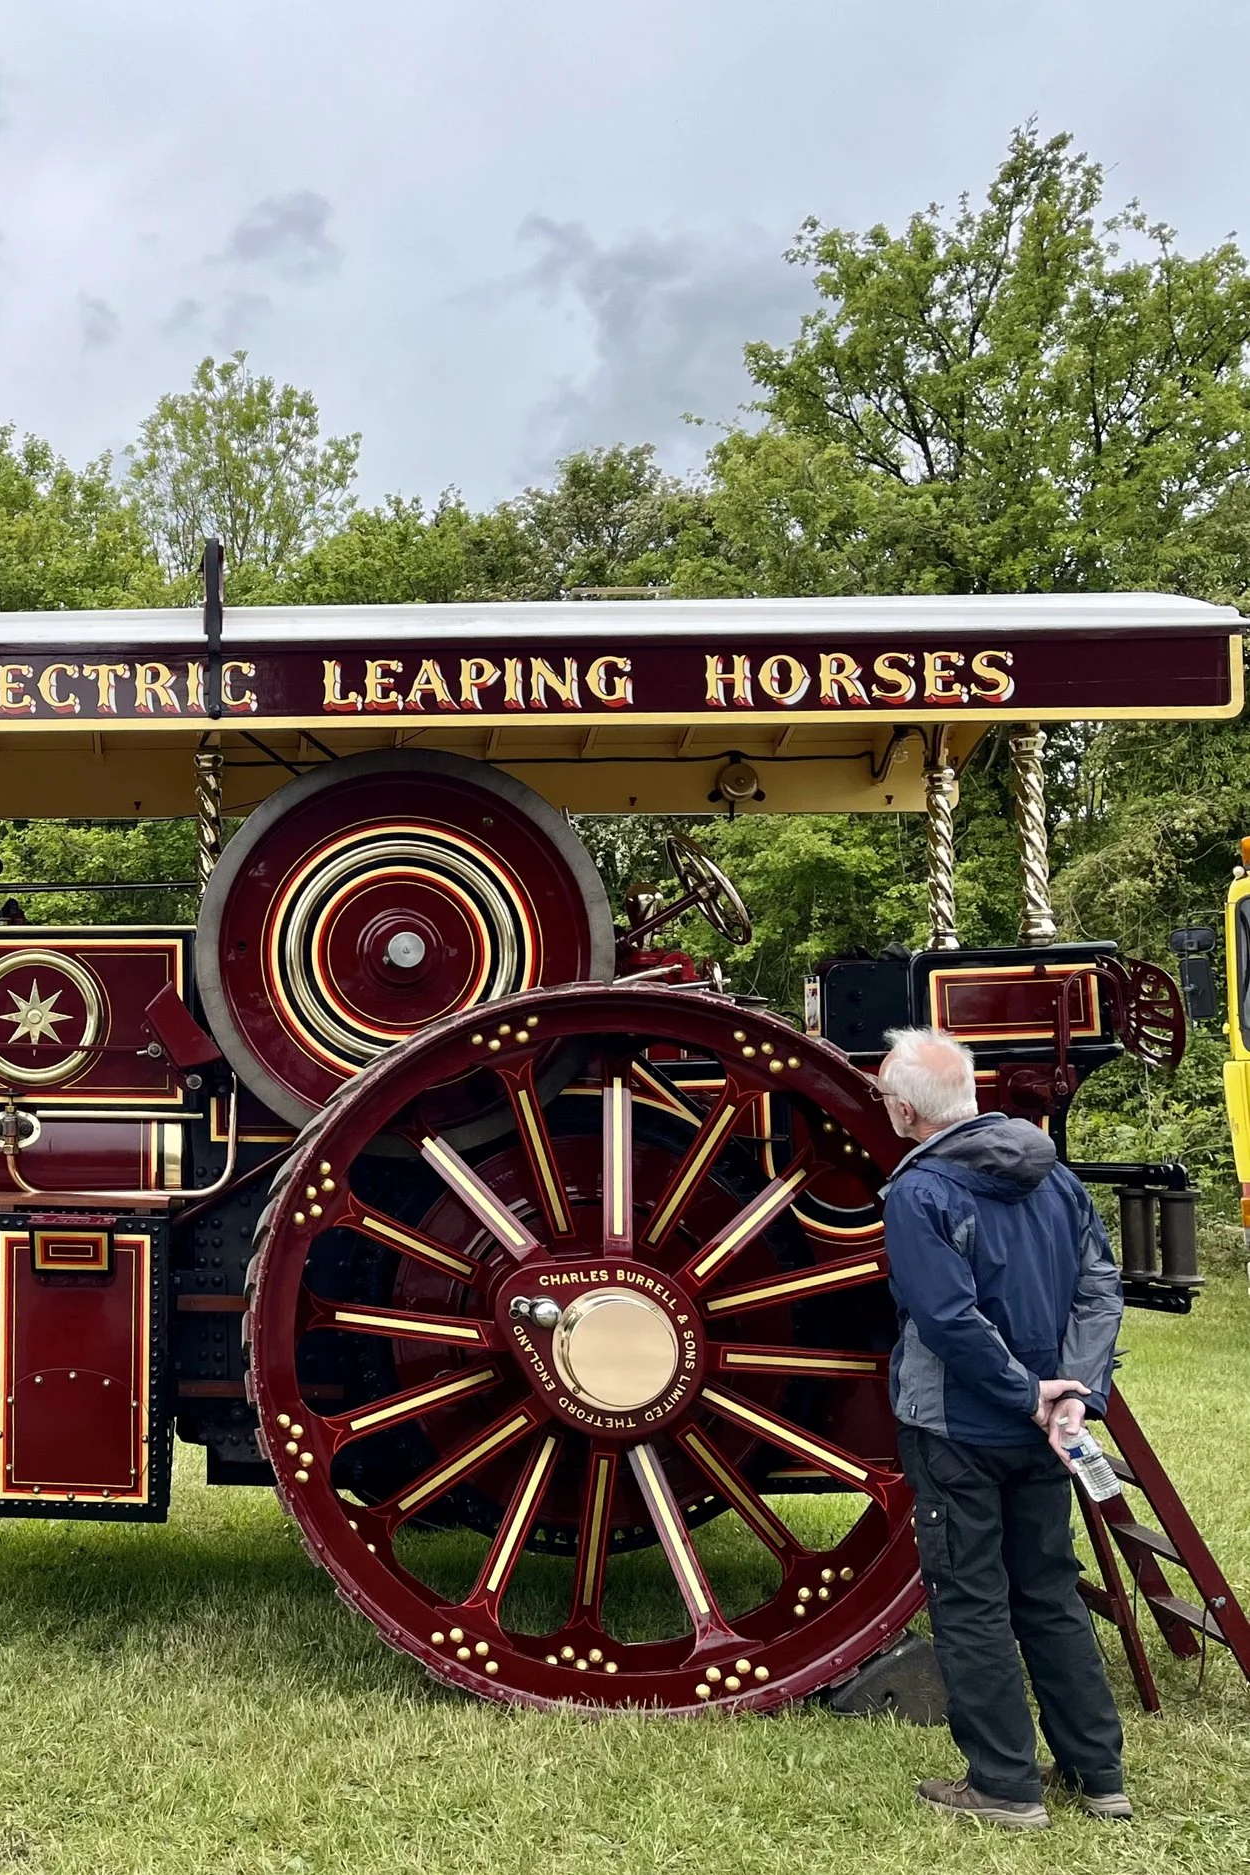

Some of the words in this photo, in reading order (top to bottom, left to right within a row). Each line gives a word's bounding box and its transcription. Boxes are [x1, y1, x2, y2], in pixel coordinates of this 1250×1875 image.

[322, 655, 633, 712] LEAPING
[704, 650, 1016, 708] HORSES
[538, 1269, 609, 1287] CHARLES
[616, 1269, 677, 1311] BURRELL
[676, 1314, 688, 1325] &
[513, 1325, 556, 1392] ENGLAND
[683, 1330, 696, 1370] SONS
[558, 1396, 637, 1429] THETFORD
[644, 1375, 691, 1422] LIMITED
